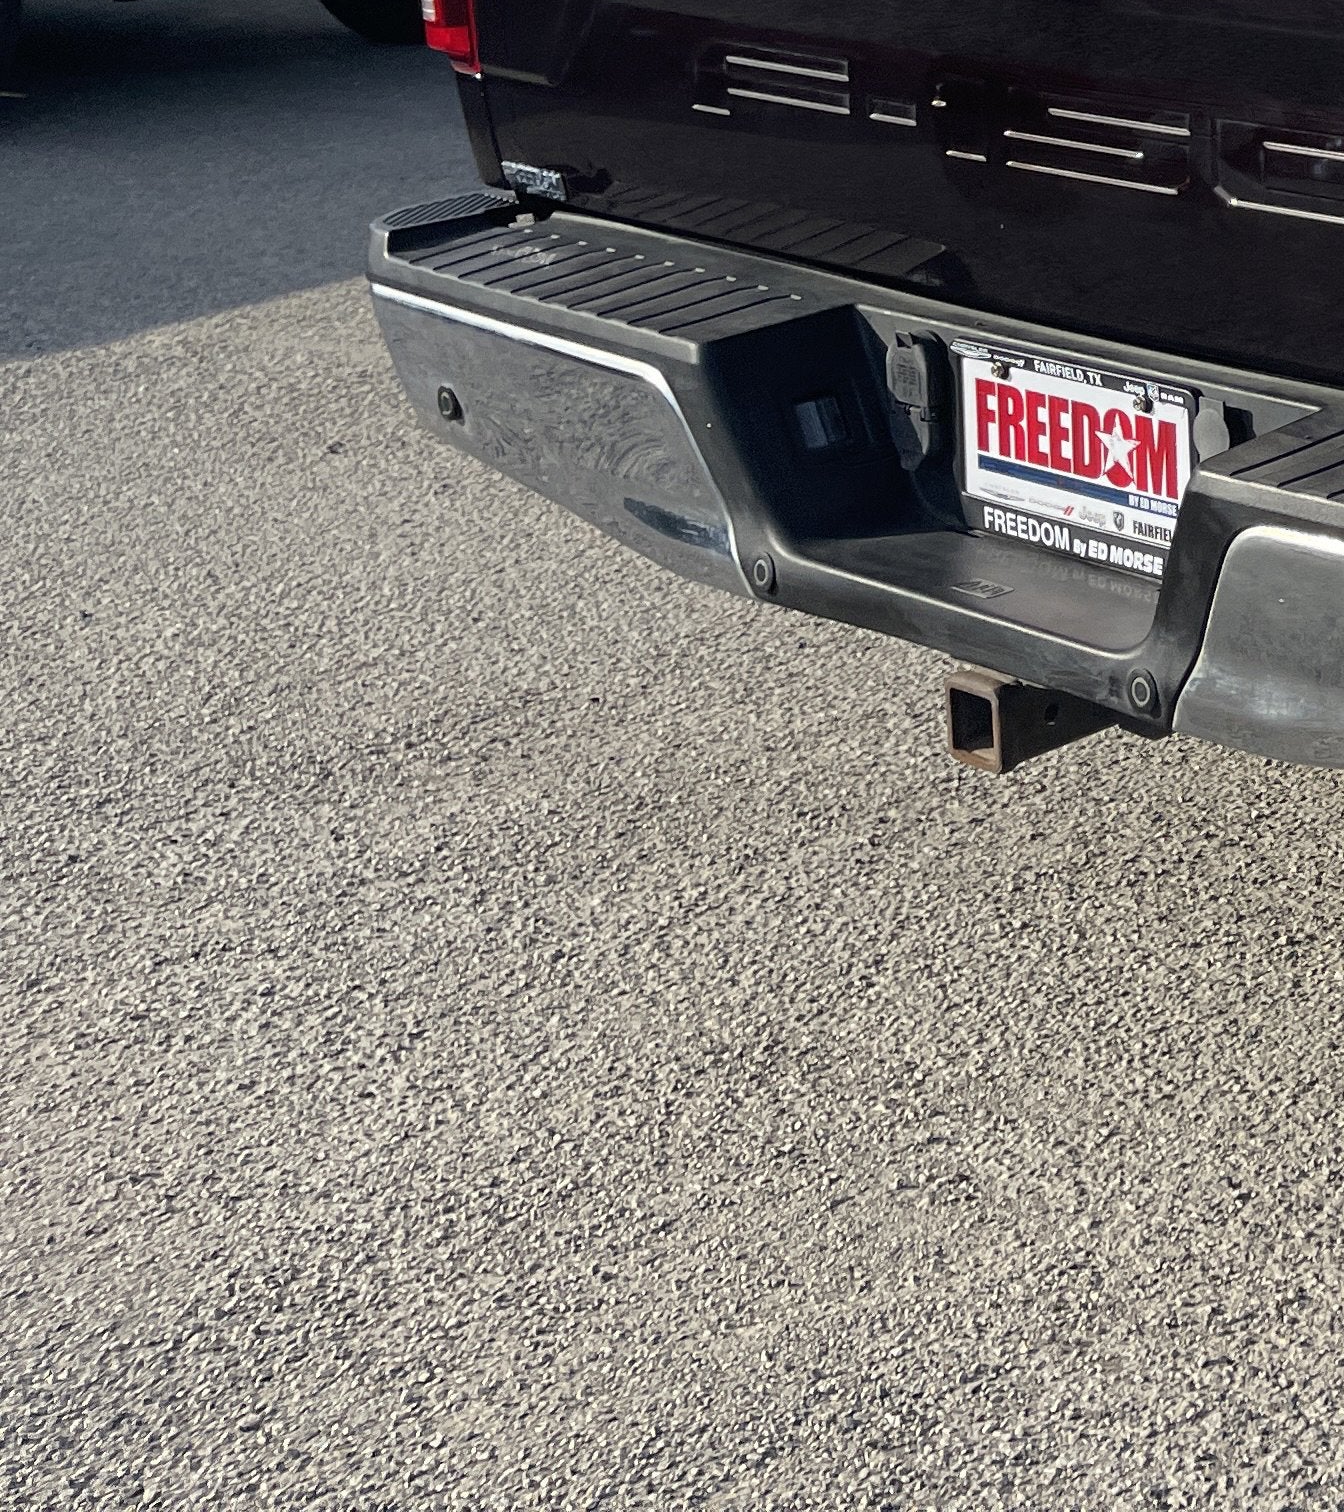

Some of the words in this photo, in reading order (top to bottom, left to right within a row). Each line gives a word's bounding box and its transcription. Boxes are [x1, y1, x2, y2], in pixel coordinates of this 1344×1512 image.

[1034, 360, 1087, 384] FAIRFIELD,
[1087, 372, 1103, 387] TX
[975, 378, 1178, 500] FREEDOM
[984, 506, 1071, 551] FREEDOM
[1087, 539, 1109, 561] ED
[1109, 544, 1164, 576] MORSE
[1132, 520, 1173, 543] FAIRFIEL
